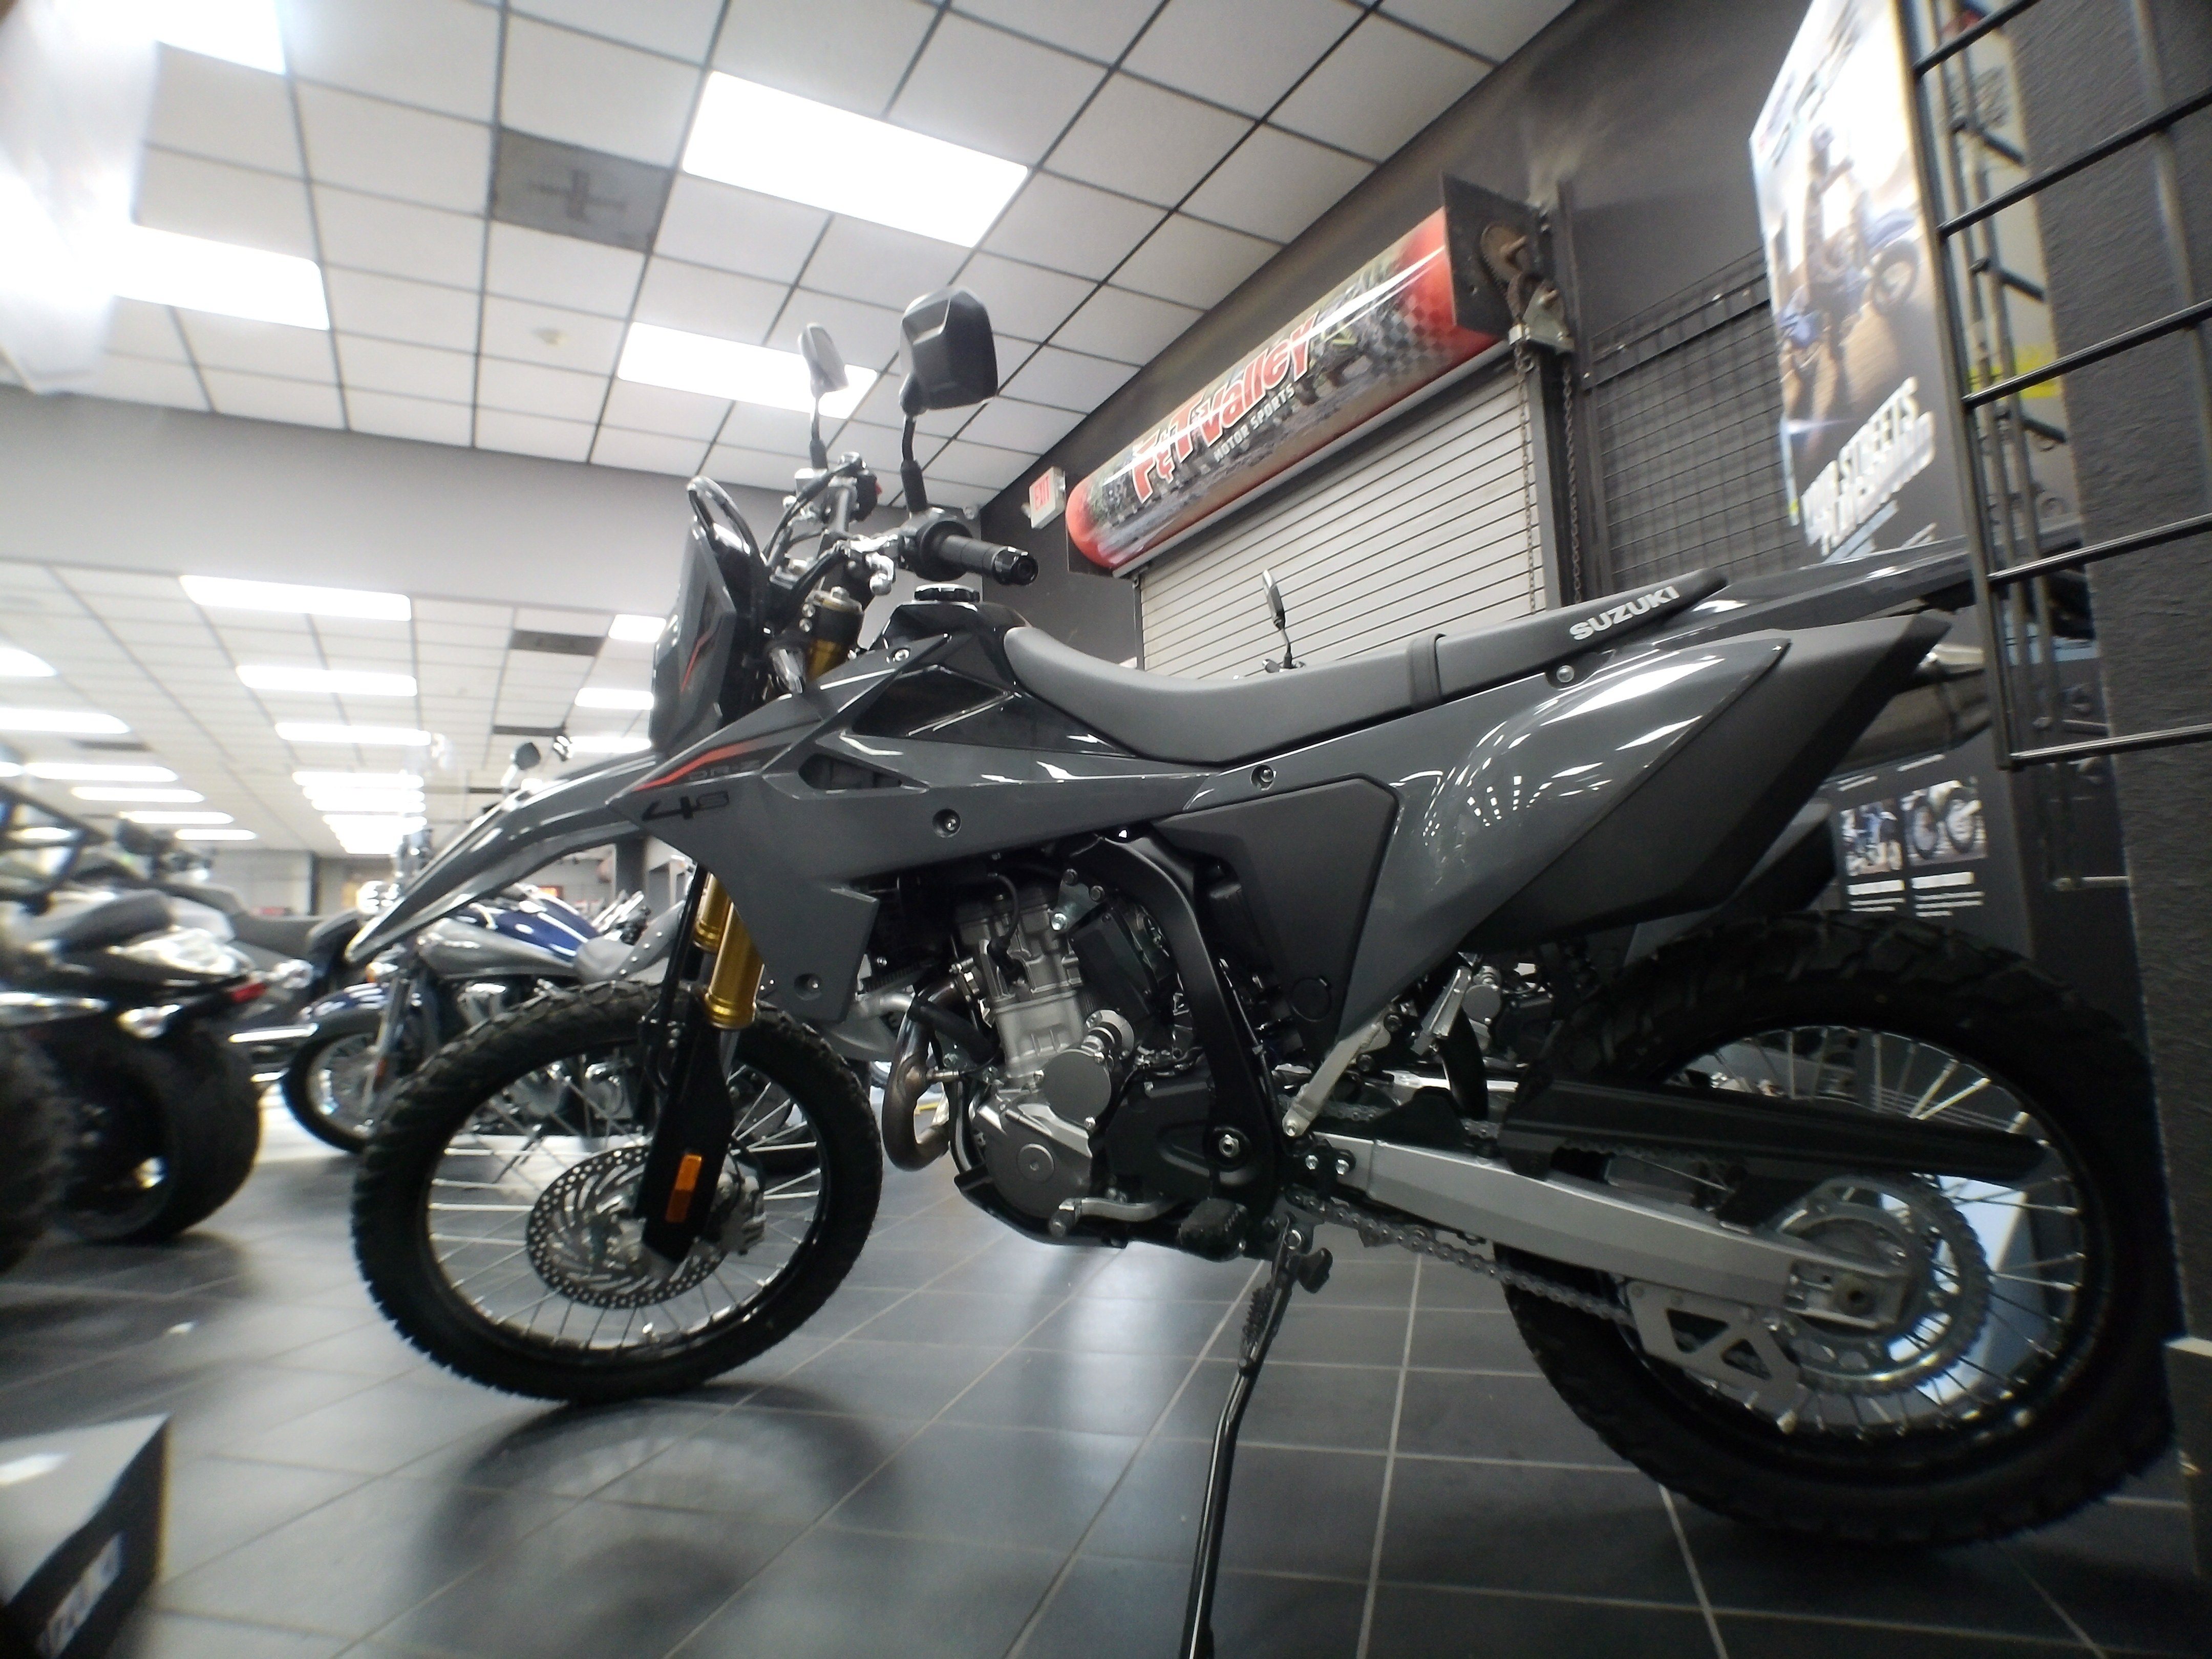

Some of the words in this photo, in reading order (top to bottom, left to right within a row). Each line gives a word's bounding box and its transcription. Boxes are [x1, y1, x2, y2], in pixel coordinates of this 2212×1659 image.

[1213, 423, 1250, 463] MOTOR
[1250, 382, 1295, 430] SPORTS
[1034, 474, 1051, 512] EXIT
[1568, 585, 1681, 641] SUZUKI
